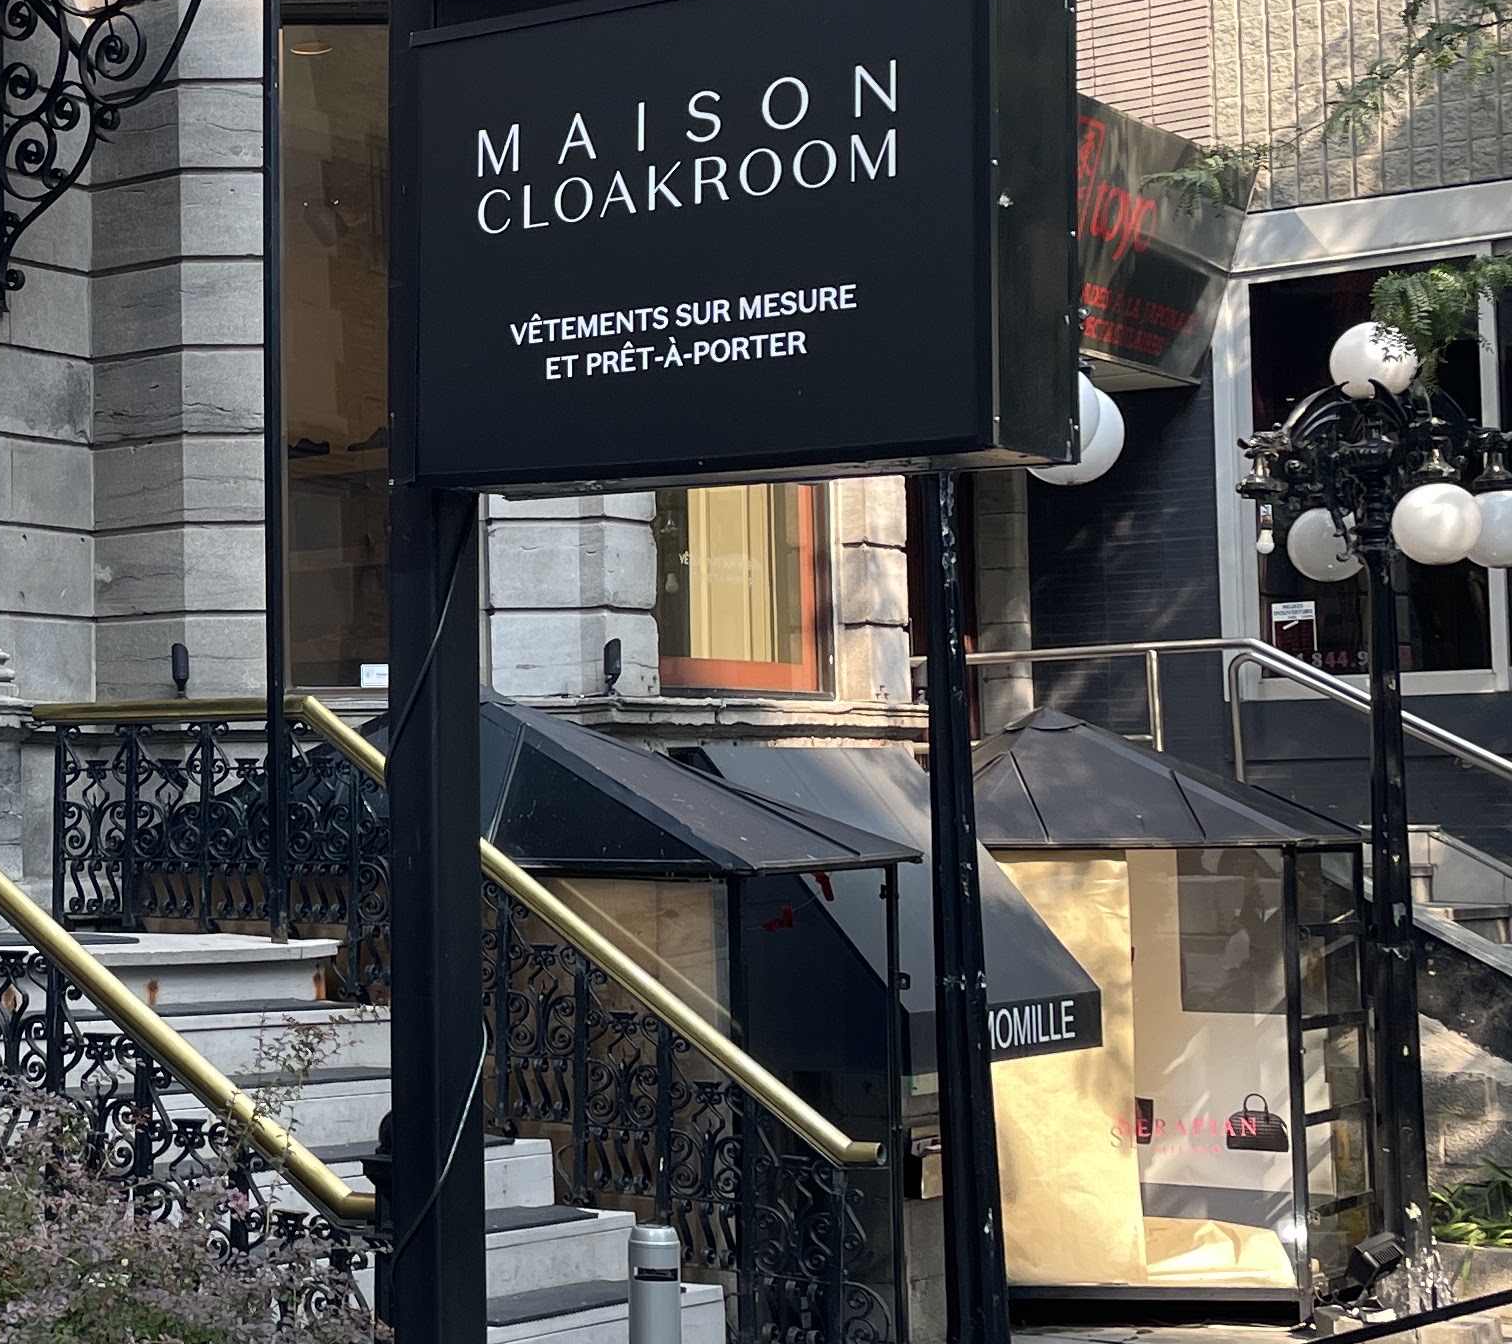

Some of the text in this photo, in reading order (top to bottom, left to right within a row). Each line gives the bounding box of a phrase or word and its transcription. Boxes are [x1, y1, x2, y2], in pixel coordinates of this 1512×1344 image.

[476, 58, 898, 179] MAISON
[476, 128, 898, 235] CLOAKROOM
[509, 283, 858, 346] VÊTEMENTS SUR MESURE
[545, 330, 808, 381] ET PRÊT-À-PORTER
[1116, 1115, 1258, 1138] SERAPIAN
